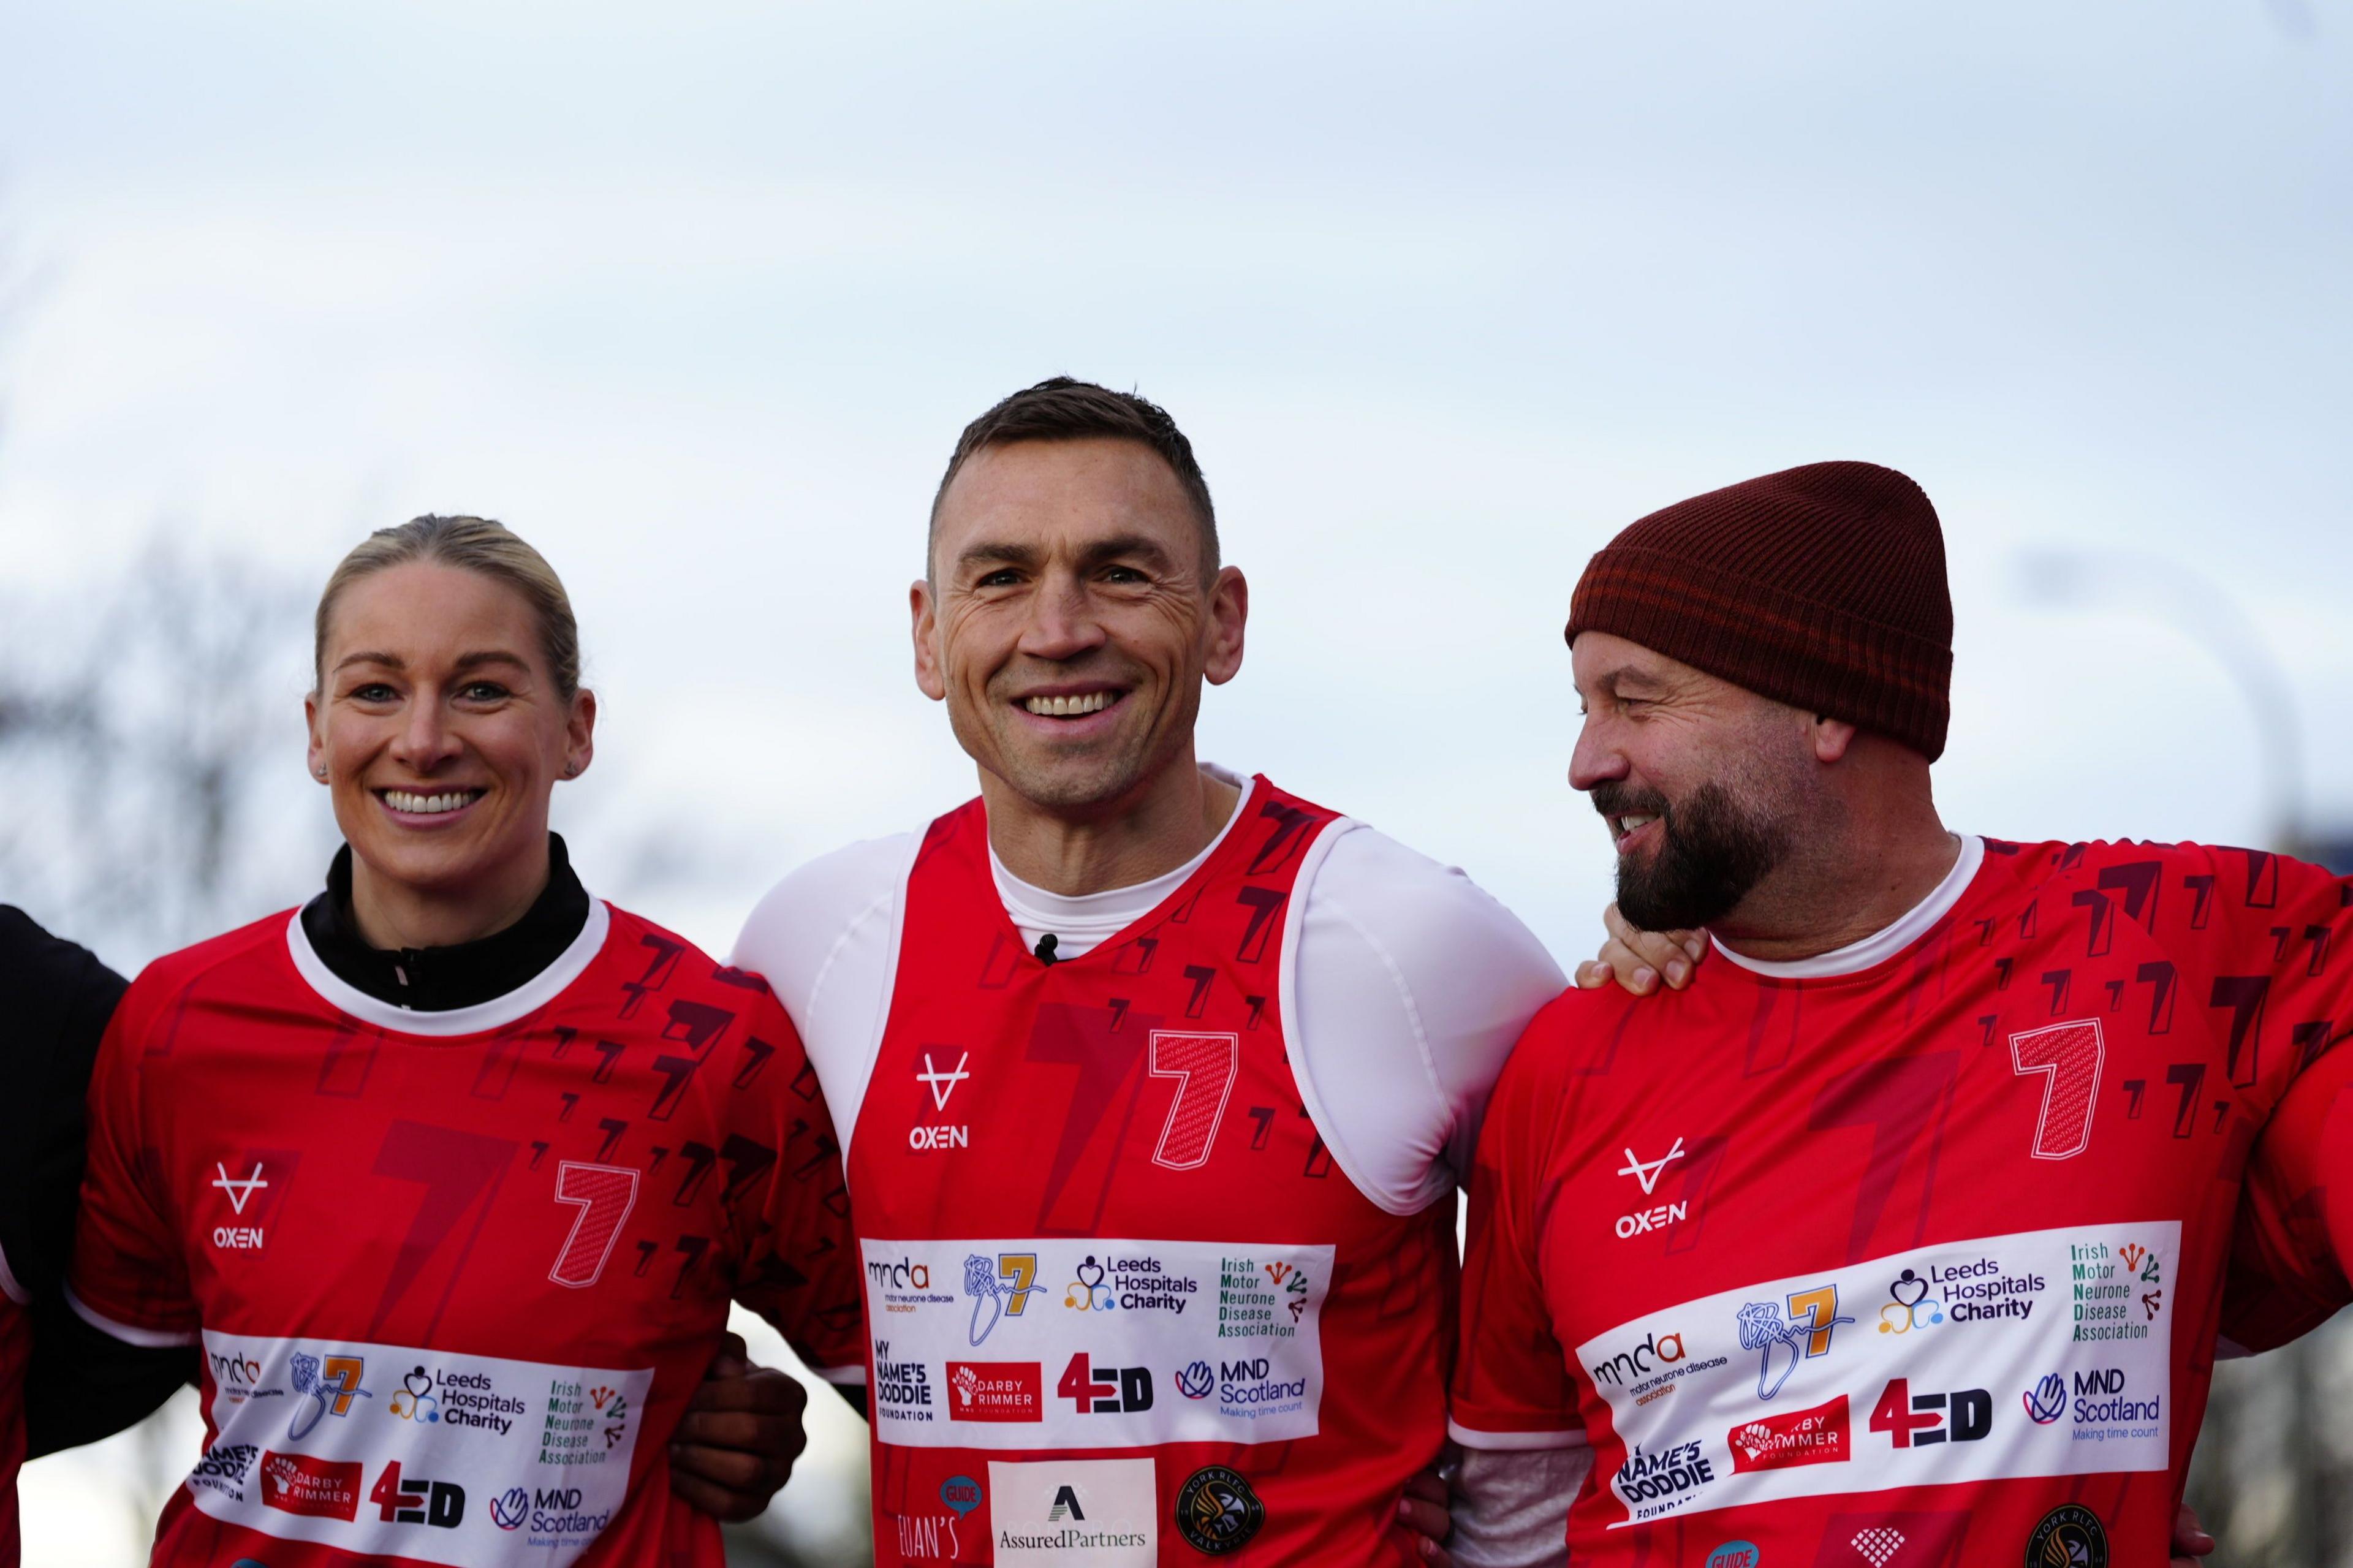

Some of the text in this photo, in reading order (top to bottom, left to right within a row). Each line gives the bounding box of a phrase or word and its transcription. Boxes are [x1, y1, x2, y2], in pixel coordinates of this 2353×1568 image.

[2009, 1018, 2105, 1159] 7
[1150, 1029, 1238, 1171] 7
[909, 1126, 968, 1150] OXEN
[548, 1161, 640, 1288] 7
[1615, 1201, 1687, 1240] OXEN
[213, 1228, 262, 1249] OXEN
[2071, 1243, 2108, 1261] Irish
[868, 1257, 929, 1289] mnda
[1107, 1257, 1161, 1273] Leeds
[1222, 1257, 1254, 1273] Irish
[1931, 1258, 1999, 1284] Leeds
[2074, 1263, 2115, 1281] Motor
[998, 1253, 1037, 1316] 7
[1115, 1275, 1197, 1293] Hospitals
[1221, 1275, 1259, 1289] Motor
[1944, 1274, 2045, 1303] Hospitals
[927, 1294, 953, 1303] disease
[1220, 1291, 1275, 1305] Neurone
[2074, 1284, 2130, 1301] Neurone
[1120, 1294, 1186, 1314] Charity
[1219, 1308, 1271, 1320] Disease
[1950, 1299, 2033, 1322] Charity
[2074, 1304, 2126, 1321] Disease
[1218, 1324, 1295, 1338] Association
[1787, 1283, 1838, 1359] 7
[2073, 1323, 2148, 1343] Association
[876, 1340, 889, 1360] MY
[1594, 1332, 1686, 1385] mnda
[437, 1369, 491, 1390] Leeds
[1221, 1358, 1269, 1381] MND
[1630, 1355, 1728, 1397] motor neurone disease
[324, 1355, 363, 1417] 7
[551, 1381, 581, 1396] Irish
[978, 1380, 1023, 1392] DARBY
[1220, 1378, 1305, 1403] Scotland
[2074, 1369, 2124, 1396] MND
[442, 1390, 525, 1415] Hospitals
[879, 1385, 931, 1404] DODDIE
[979, 1395, 1032, 1405] RIMMER
[1635, 1382, 1675, 1406] association
[548, 1398, 583, 1414] Motor
[879, 1408, 933, 1421] FOUNDATION
[1220, 1401, 1302, 1419] Making time count
[2074, 1395, 2159, 1424] Scotland
[445, 1409, 512, 1435] Charity
[545, 1415, 594, 1430] Neurone
[542, 1432, 588, 1447] Disease
[2072, 1426, 2158, 1442] Making time count
[539, 1449, 605, 1464] Association
[1763, 1447, 1838, 1460] FOUNDATION
[297, 1474, 342, 1488] DARBY
[1187, 1471, 1245, 1494] YORK RLFC
[1621, 1459, 1715, 1503] DODDIE
[294, 1486, 351, 1504] RIMMER
[534, 1488, 582, 1510] MND
[945, 1485, 976, 1502] GUIDE
[531, 1510, 609, 1532] Scotland
[2037, 1510, 2097, 1540] YORK RLFC
[898, 1515, 959, 1559] EUAN'S
[1000, 1529, 1145, 1549] AssuredPartners
